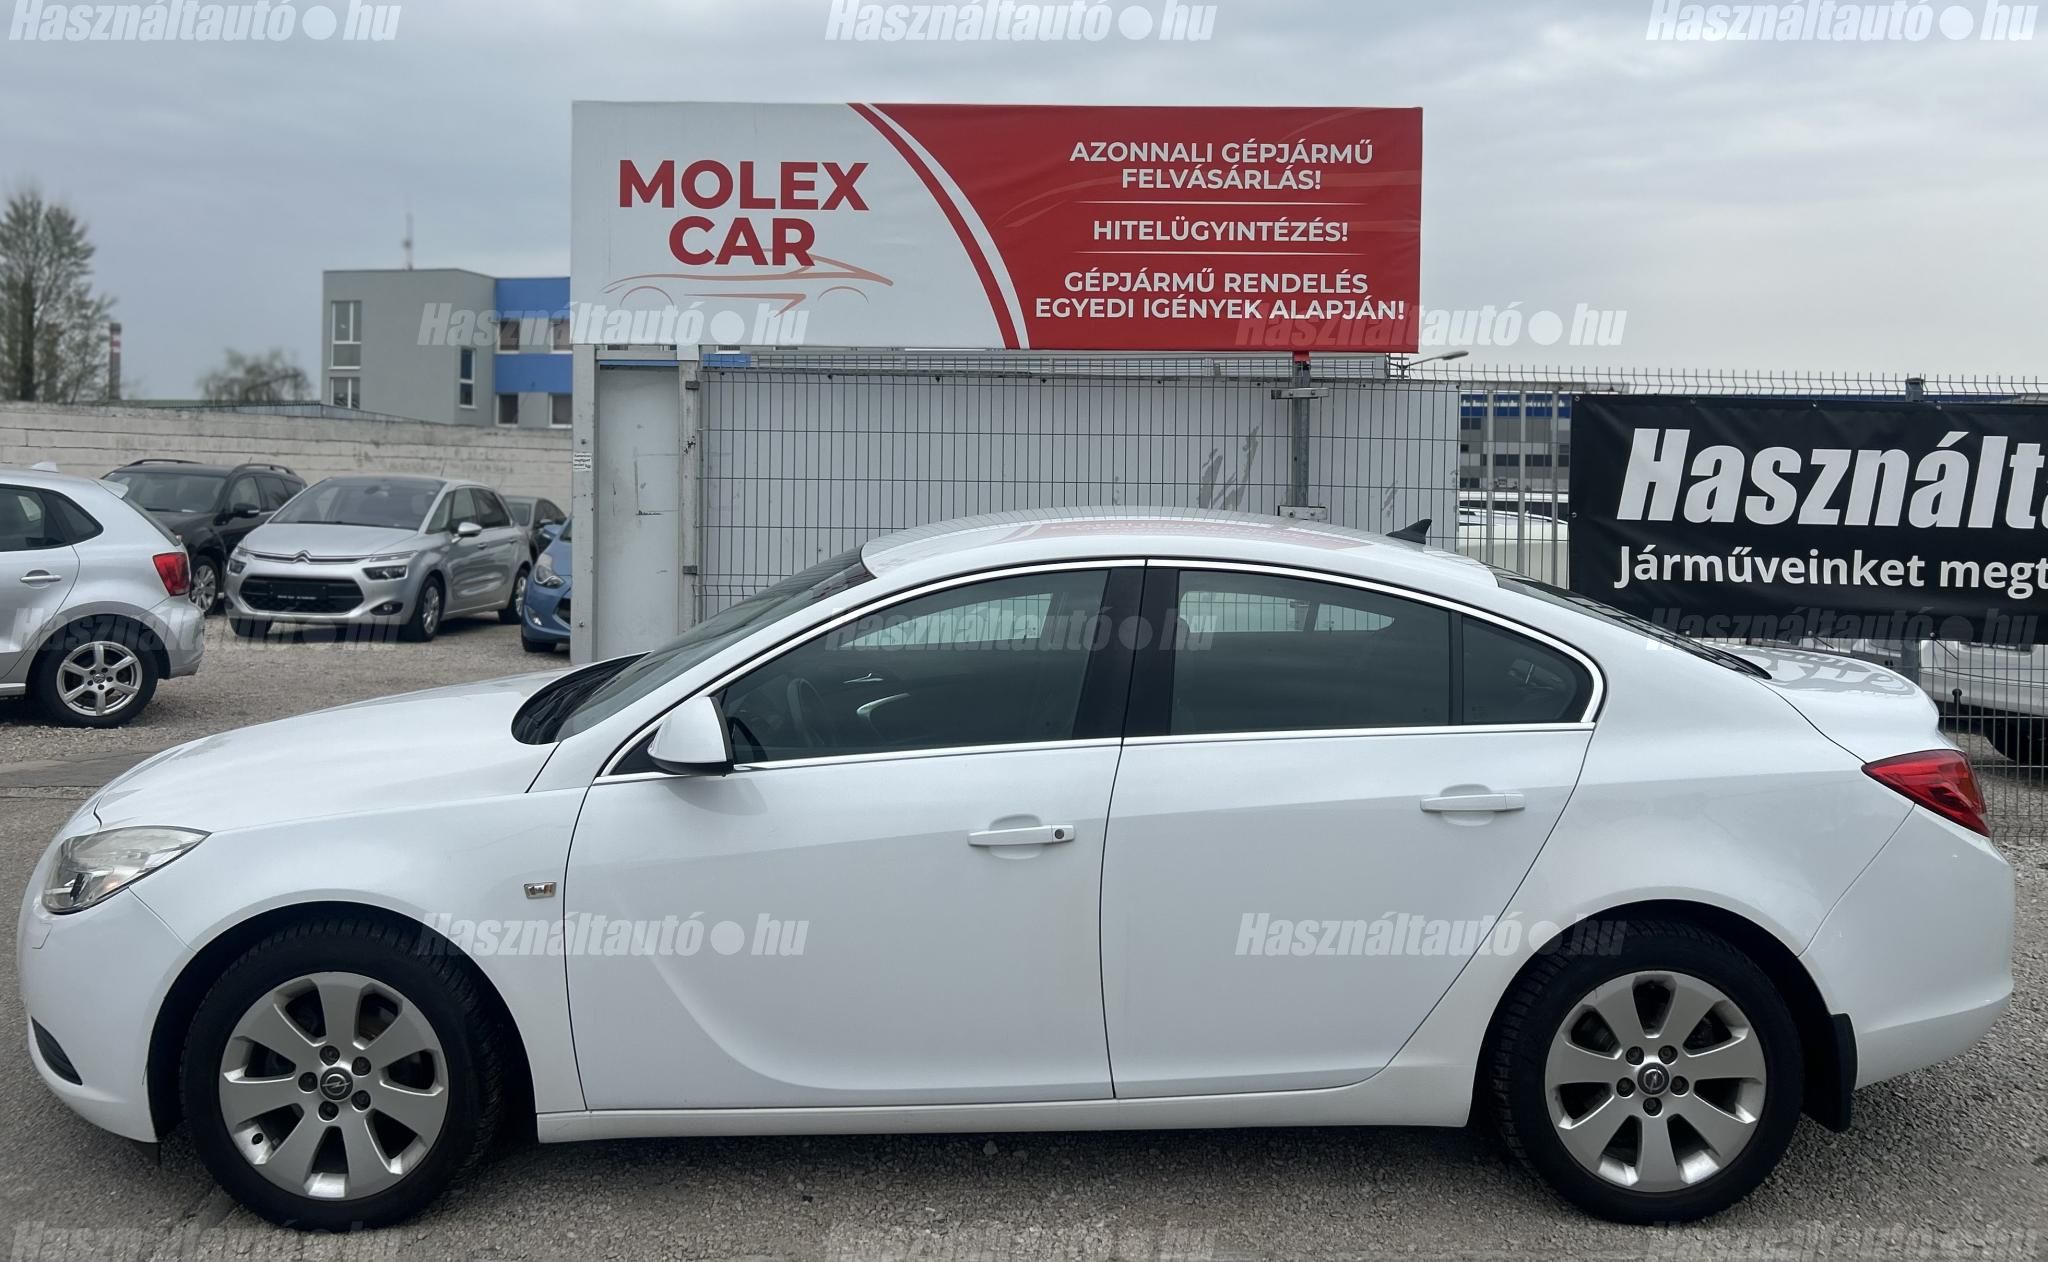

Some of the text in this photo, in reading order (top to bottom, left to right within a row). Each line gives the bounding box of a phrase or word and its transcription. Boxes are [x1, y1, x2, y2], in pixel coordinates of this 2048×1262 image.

[1069, 138, 1374, 165] AZONNALI GÉPJÁRMŰ
[618, 159, 870, 212] MOLEX
[1121, 164, 1322, 191] FELVÁSÁRLÁS!
[668, 215, 816, 267] CAR
[1093, 216, 1349, 242] HITELÜGYINTÉZÉS!
[1064, 267, 1369, 294] GÉPJÁRMŰ RENDELÉS
[1035, 293, 1405, 321] EGYEDI IGÉNYEK ALAPJÁN!
[1616, 428, 2048, 530] Használt
[1614, 545, 1925, 588] Járműveinket
